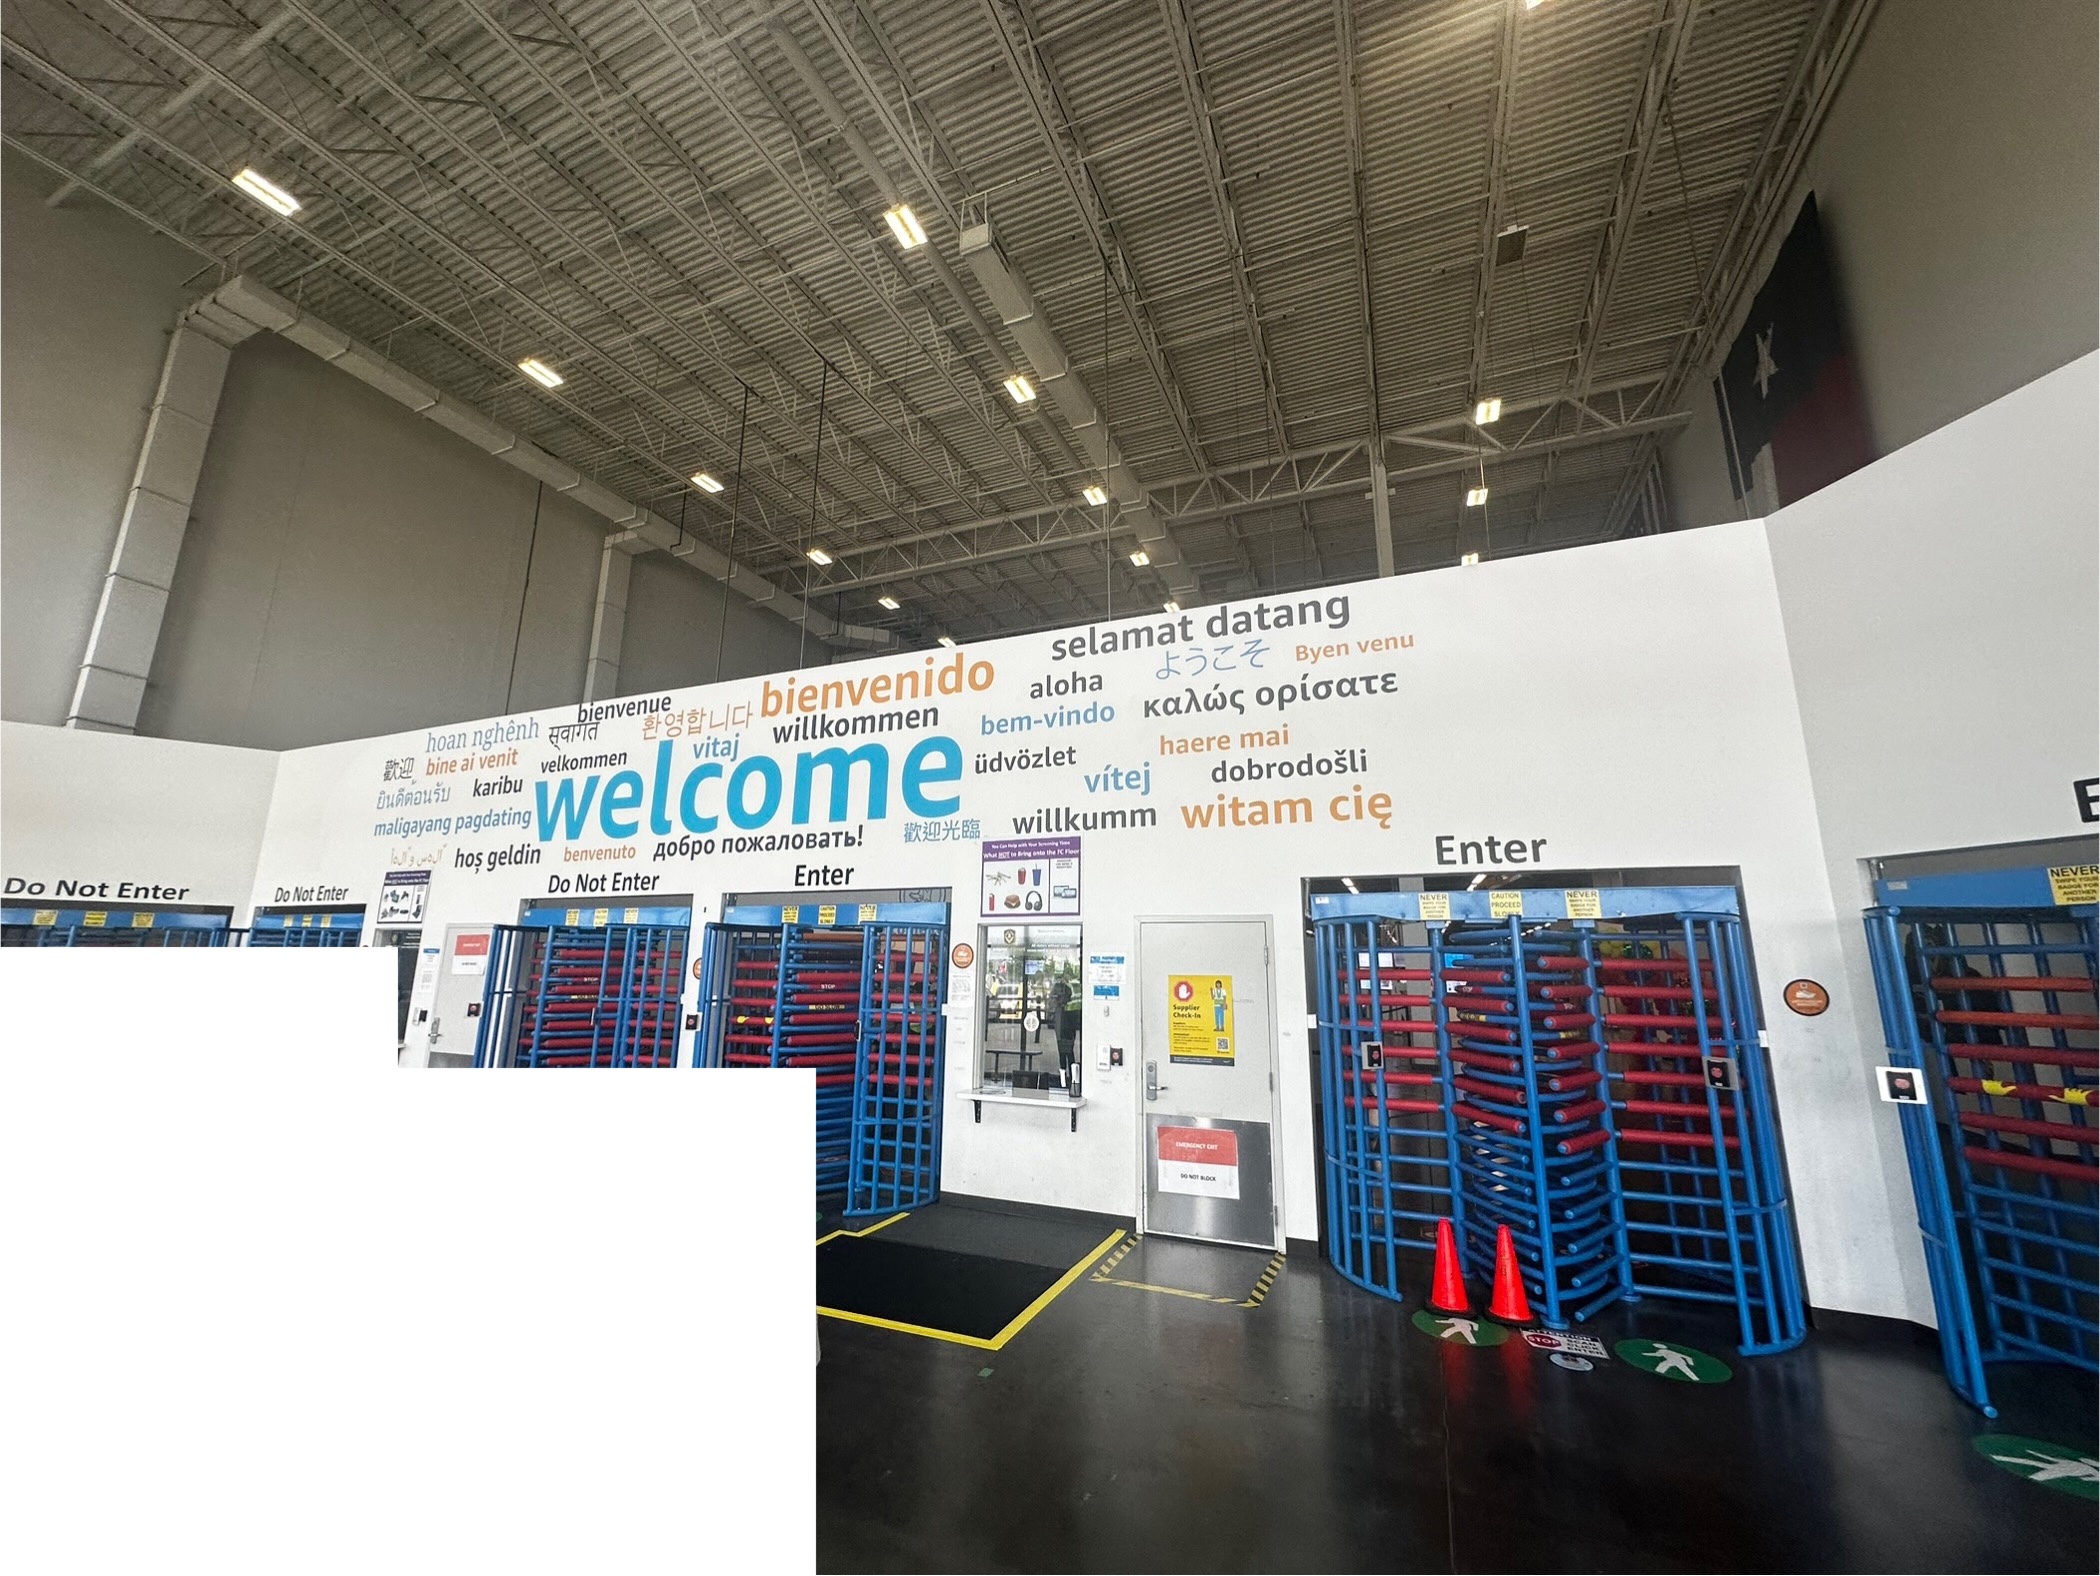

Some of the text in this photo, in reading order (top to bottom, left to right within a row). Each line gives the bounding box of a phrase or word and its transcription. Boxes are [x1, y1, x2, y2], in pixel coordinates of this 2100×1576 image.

[1051, 595, 1350, 662] selamat datang
[1155, 639, 1271, 681] ようこそ
[1295, 634, 1415, 664] Byen venu
[760, 652, 995, 718] bienvenido
[1029, 672, 1104, 700] aloha
[1143, 671, 1399, 720] καλώς ορίσατε
[577, 696, 671, 723] bienvenue
[642, 701, 753, 740] 환영합니다
[980, 701, 1116, 736] bem-vindo
[425, 717, 540, 753] hoan nghênh
[773, 707, 939, 744] willkommen
[1159, 723, 1290, 756] haere mai
[540, 751, 627, 773] velkommen
[693, 733, 740, 762] vitaj
[974, 745, 1077, 775] üdvözlet
[383, 757, 415, 782] 歡迎
[425, 749, 519, 776] bine ai venit
[1210, 748, 1368, 784] dobrodošli
[472, 776, 523, 797] karibu
[535, 735, 963, 842] welcome
[1084, 761, 1152, 796] vítej
[1012, 806, 1157, 835] willkumm
[1181, 783, 1393, 830] witam cię
[374, 807, 532, 838] maligayang pagdating
[903, 819, 981, 844] 歡迎光臨
[487, 844, 541, 869] geldin
[563, 845, 637, 862] benvenuto
[653, 825, 864, 862] добро пожаловать!
[1435, 835, 1547, 866] Enter
[548, 872, 660, 894] Do Not Enter
[794, 864, 854, 887] Enter
[2050, 865, 2099, 877] NEVER
[4, 877, 190, 901] Do Not Enter
[275, 885, 349, 903] Do Not Enter
[1420, 893, 1447, 901] NEVER
[1175, 1141, 1206, 1150] EMERGENCY
[1528, 1335, 1559, 1345] STOP
